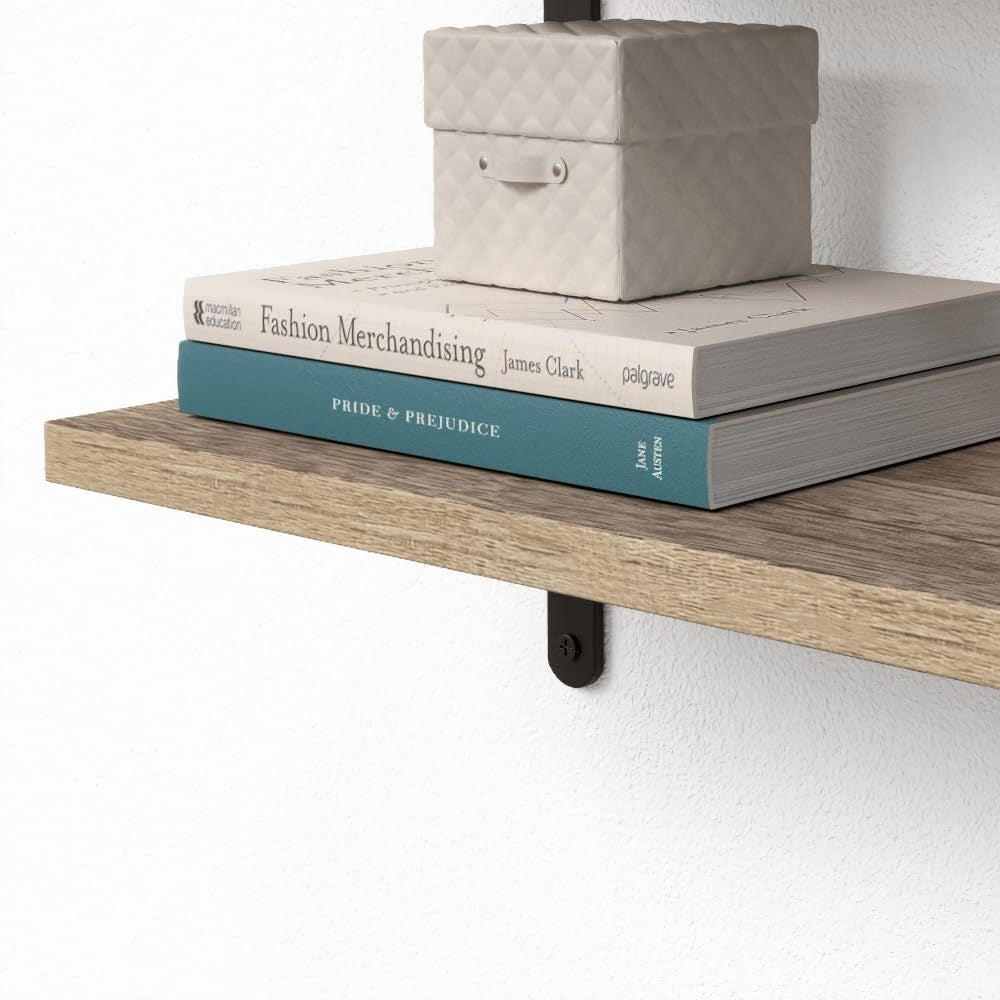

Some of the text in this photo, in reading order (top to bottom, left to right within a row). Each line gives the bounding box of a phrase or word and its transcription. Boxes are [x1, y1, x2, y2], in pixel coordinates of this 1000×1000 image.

[259, 303, 676, 390] Fashion Merchandising James Clark palgrave
[332, 397, 501, 439] PRIDE & PREJUDICE
[635, 440, 649, 471] JANE
[651, 435, 663, 481] AUSTEN
